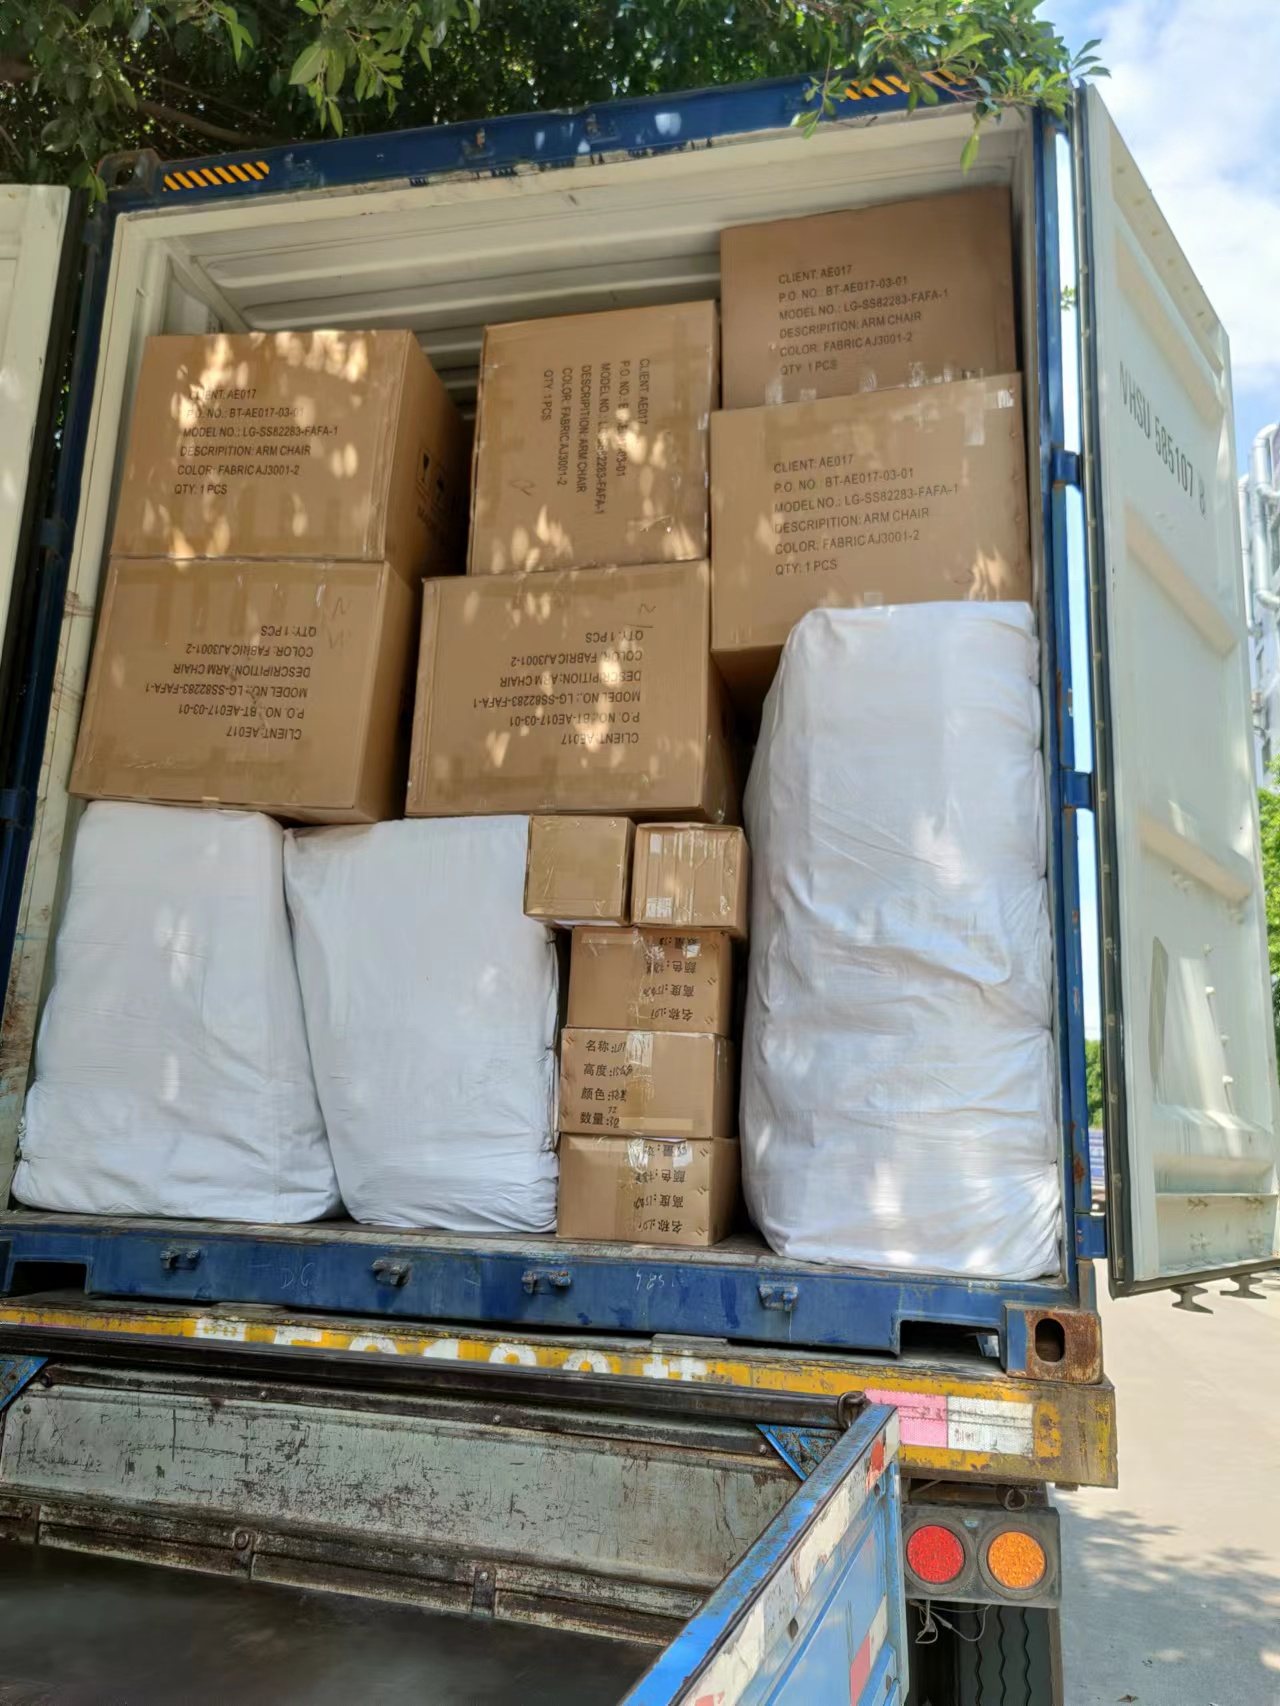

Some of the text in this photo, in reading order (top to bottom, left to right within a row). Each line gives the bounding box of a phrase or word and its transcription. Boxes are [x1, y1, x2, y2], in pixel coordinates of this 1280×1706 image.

[820, 264, 853, 278] AE017
[826, 275, 907, 296] BT-AE017-03-01
[779, 307, 816, 320] MODEL
[844, 288, 948, 313] LG-SS82283-FAFA-1
[861, 316, 885, 329] ARM
[887, 311, 922, 325] CHAIR
[823, 337, 863, 352] FABRIC
[865, 331, 913, 348] AJ3001-2
[815, 359, 838, 372] PCS
[600, 362, 611, 396] MODEL
[227, 388, 257, 400] AE017
[541, 401, 552, 421] PCS
[638, 396, 648, 425] AE017
[559, 406, 571, 441] FABRIC
[183, 426, 217, 438] MODEL
[242, 425, 338, 438] LG-SS82283-FAFA-1
[255, 445, 278, 457] ARM
[279, 445, 311, 457] CHAIR
[578, 439, 589, 459] ARM
[1155, 415, 1193, 497] 585107
[557, 443, 569, 486] AJ3001-2
[819, 454, 854, 469] AE017
[218, 464, 254, 476] FABRIC
[255, 464, 300, 476] AJ3001-2
[576, 462, 587, 493] CHAIR
[825, 467, 914, 488] BT-AE017-03-01
[207, 484, 228, 495] PCS
[775, 499, 815, 513] MODEL
[844, 483, 959, 506] LG-SS82283-FAFA-1
[863, 511, 889, 525] ARM
[892, 507, 929, 522] CHAIR
[822, 534, 867, 551] FABRIC
[867, 529, 920, 545] AJ3001-2
[813, 559, 838, 572] PCS
[260, 625, 282, 637] PCS
[585, 631, 608, 644] PCS
[185, 643, 231, 656] AJ3001-2
[511, 654, 557, 667] AJ3001-2
[558, 651, 597, 665] FABRIC
[173, 663, 206, 675] CHAIR
[207, 663, 230, 676] ARM
[500, 675, 533, 688] CHAIR
[145, 682, 243, 696] LG-SS82283-FAFA-1
[271, 686, 309, 698] MODEL
[473, 693, 574, 709] LG-SS82283-FAFA-1
[602, 691, 641, 703] MODEL
[178, 704, 257, 718] BT-AE017-03-01
[509, 712, 590, 727] BT-AE017-03-01
[226, 725, 259, 738] AE017
